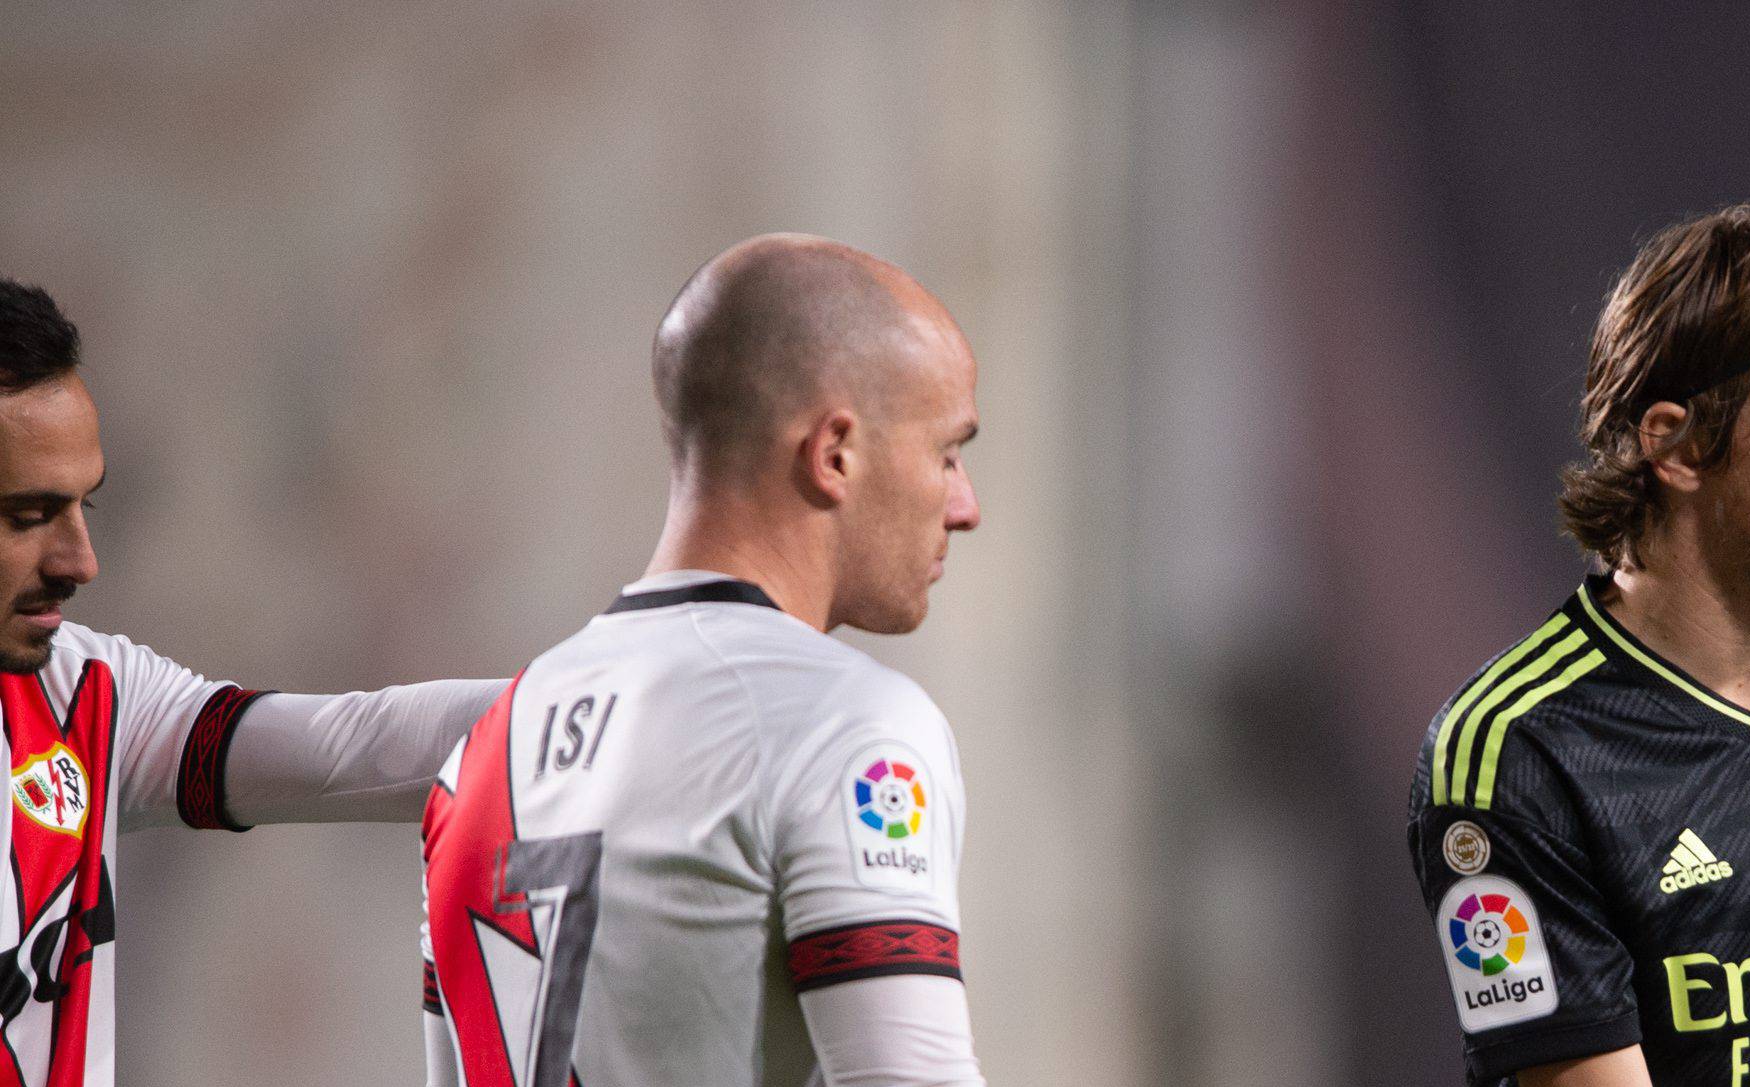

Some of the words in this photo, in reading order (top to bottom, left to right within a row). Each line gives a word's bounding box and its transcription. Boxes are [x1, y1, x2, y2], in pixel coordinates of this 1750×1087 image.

[534, 693, 618, 780] ISI
[1659, 859, 1734, 895] adidas
[1464, 976, 1545, 1011] LaLiga
